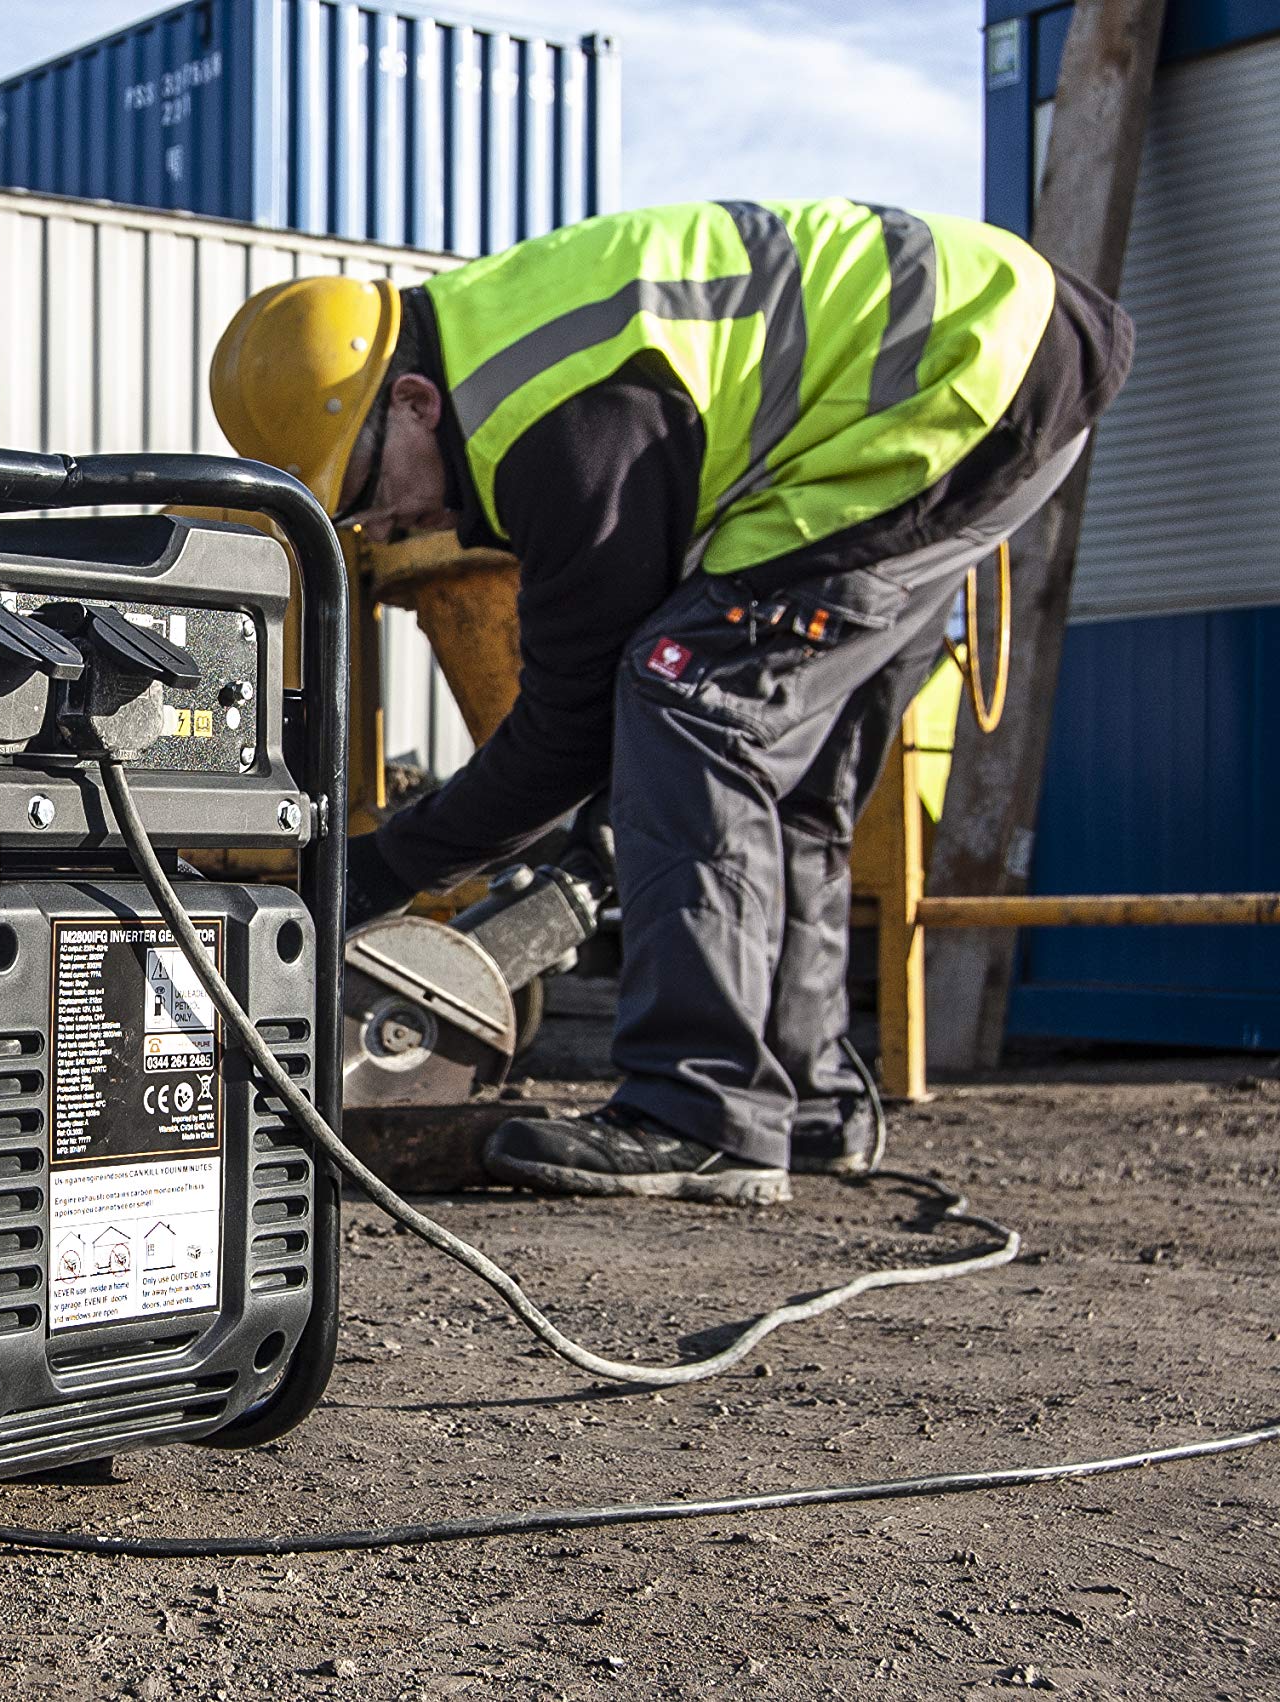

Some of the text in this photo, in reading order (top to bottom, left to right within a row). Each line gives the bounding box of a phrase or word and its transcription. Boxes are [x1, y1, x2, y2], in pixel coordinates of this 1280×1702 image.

[60, 930, 108, 944] IM2800IFG
[110, 930, 157, 943] INVERTER
[175, 1013, 192, 1023] ONLY
[146, 1054, 211, 1070] 0344 264 2485
[181, 1133, 195, 1141] Made
[160, 1167, 175, 1175] YOU
[183, 1163, 213, 1172] MINUTES
[170, 1271, 198, 1282] OUTSIDE
[84, 1296, 101, 1307] EVEN
